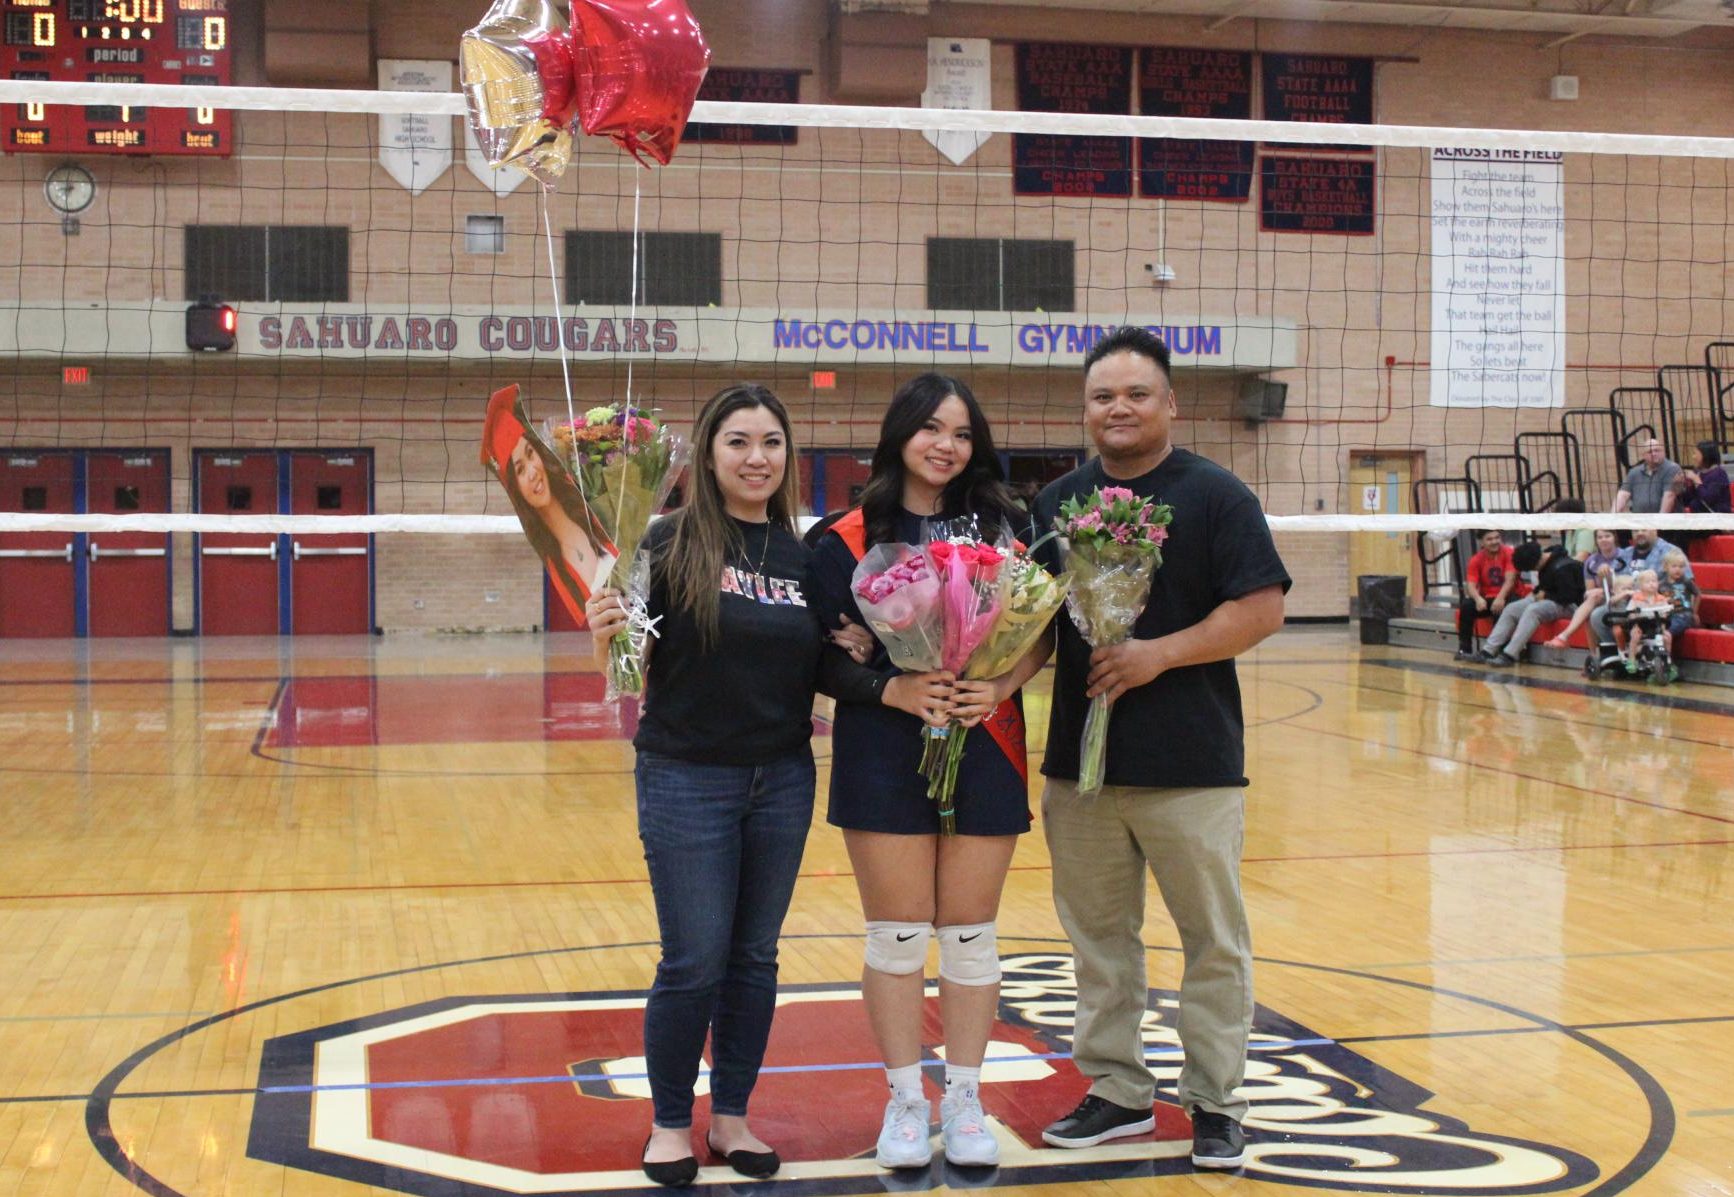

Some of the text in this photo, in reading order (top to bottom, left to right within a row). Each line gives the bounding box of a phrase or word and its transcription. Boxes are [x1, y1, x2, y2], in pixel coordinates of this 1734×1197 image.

[34, 13, 55, 46] 0
[204, 17, 226, 50] 0
[94, 48, 138, 63] period
[1284, 95, 1350, 110] FOOTBALL
[95, 129, 139, 147] weight
[1434, 147, 1491, 157] ACROSS
[1495, 149, 1521, 159] THE
[1461, 186, 1536, 198] Across the field
[1464, 263, 1479, 273] Hit
[1509, 264, 1532, 275] hard
[1446, 278, 1467, 289] And
[1497, 310, 1513, 323] get
[1534, 310, 1552, 321] ball
[258, 316, 678, 352] SAHUARO COUGARS
[773, 318, 989, 352] McCONNELL
[1455, 339, 1474, 351] The
[64, 367, 88, 384] EXIT
[1452, 370, 1471, 381] The
